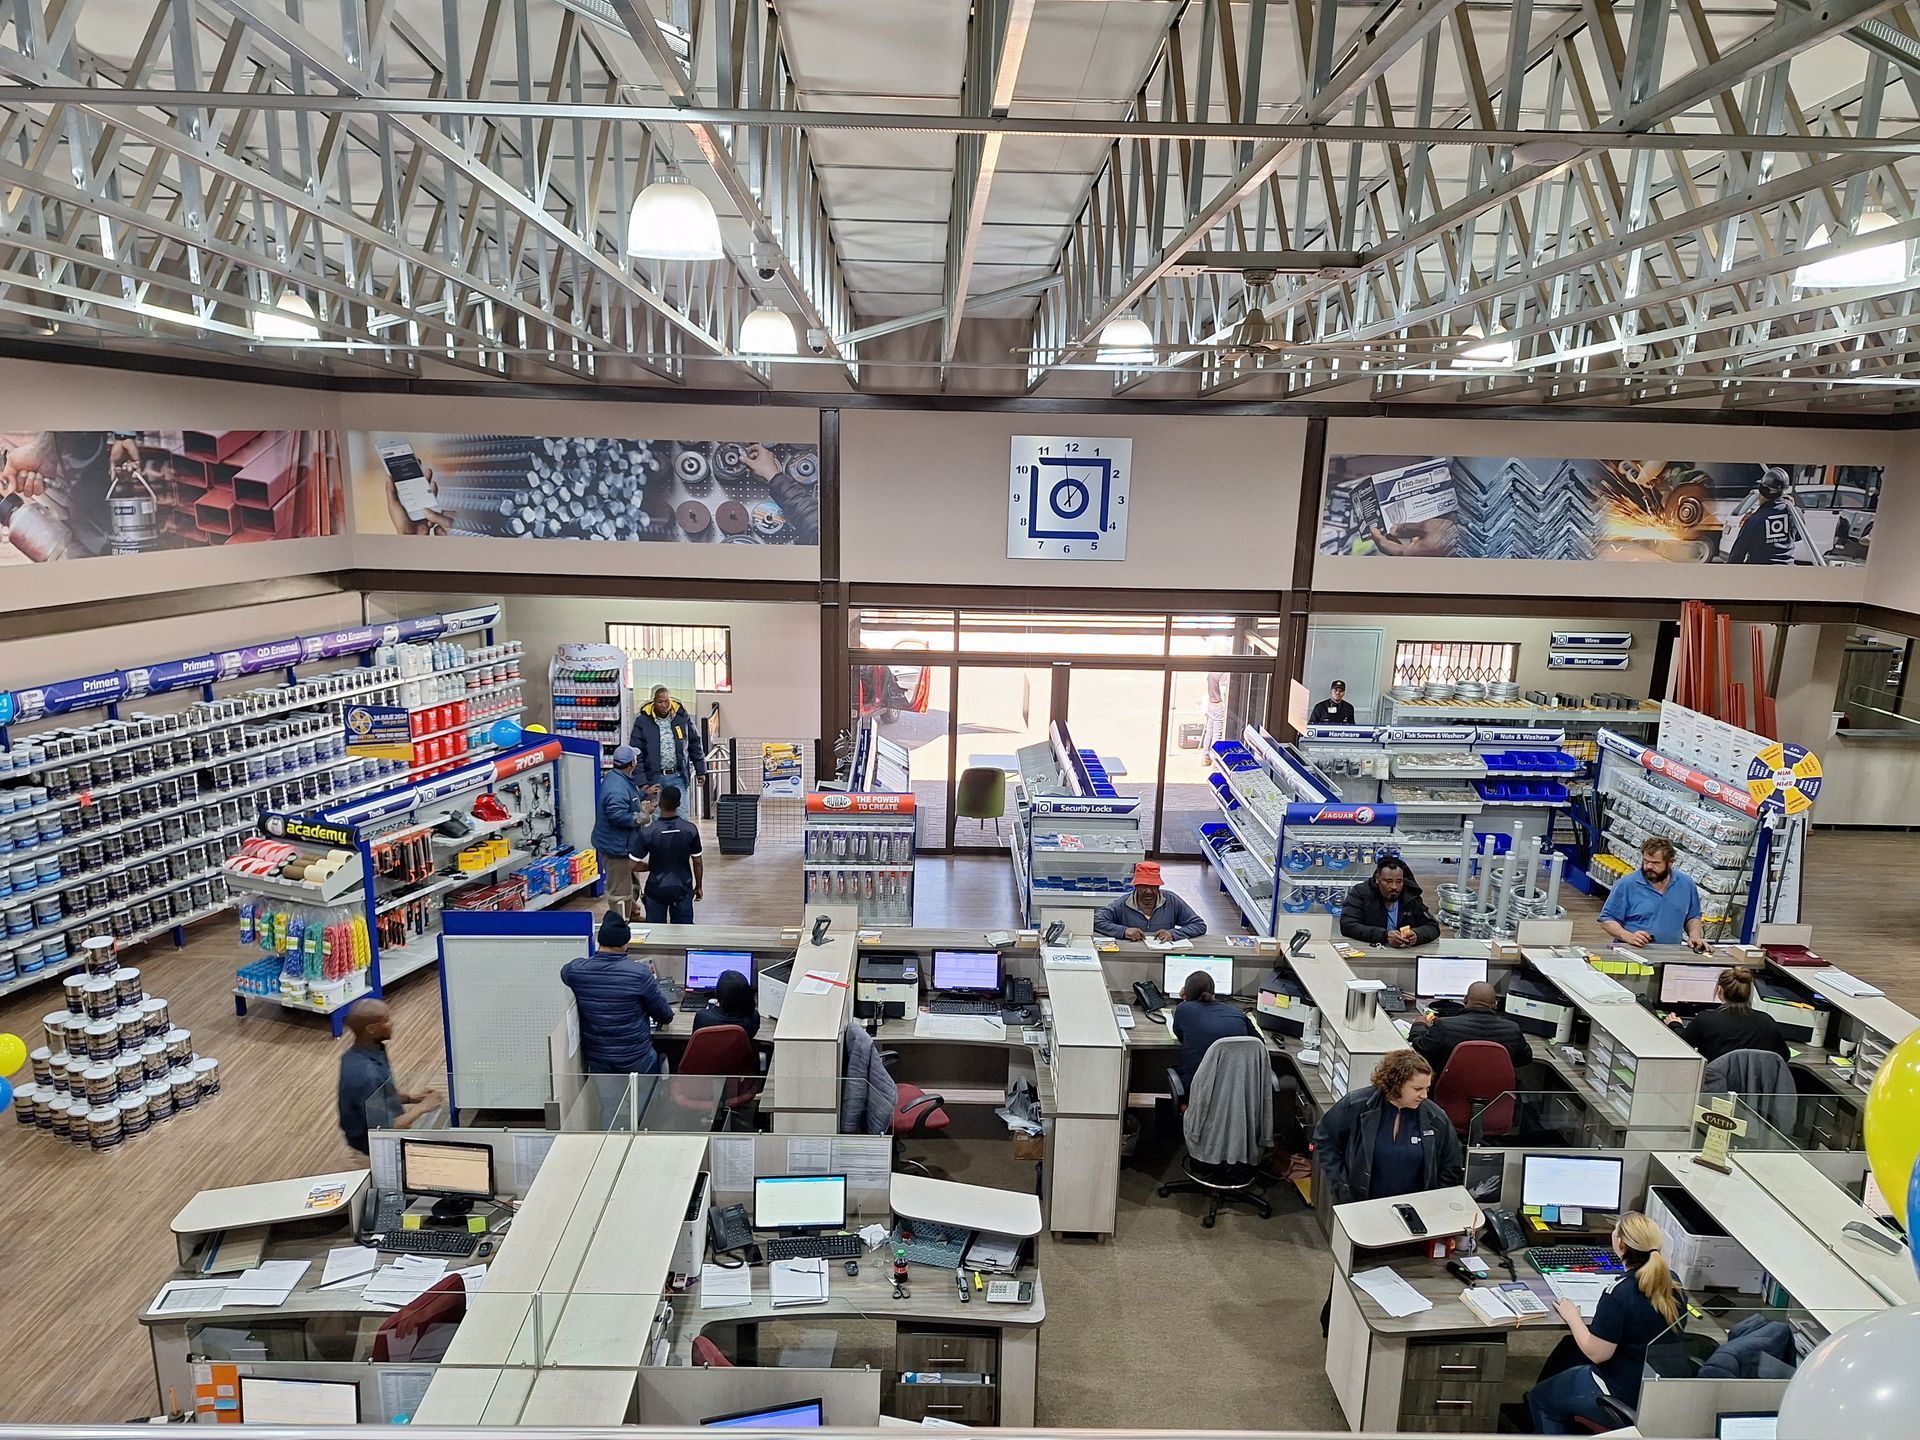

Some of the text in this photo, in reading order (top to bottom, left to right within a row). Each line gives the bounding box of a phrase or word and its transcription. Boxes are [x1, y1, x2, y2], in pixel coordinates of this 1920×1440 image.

[1037, 447, 1050, 456] 11
[1065, 443, 1079, 452] 12
[1094, 448, 1100, 457] 1
[1015, 466, 1029, 474] 10
[1112, 470, 1120, 478] 2
[1013, 494, 1021, 502] 9
[1117, 496, 1125, 504] 3
[1019, 518, 1027, 526] 8
[1108, 521, 1117, 530] 4
[1037, 541, 1045, 549] 7
[1063, 544, 1070, 553] 6
[1090, 542, 1098, 551] 5
[336, 633, 348, 644] QD
[348, 629, 372, 641] Enamel
[257, 642, 299, 657] QD Enamel
[183, 658, 215, 673] Primers
[83, 676, 120, 692] Primers
[1328, 730, 1360, 738] Hardware
[1406, 731, 1416, 739] Tek
[1442, 732, 1465, 740] Washers
[1521, 733, 1550, 741] Washers
[514, 751, 544, 772] RYOBI
[450, 775, 484, 792] Power tools
[868, 803, 898, 811] CREATE
[1060, 805, 1112, 814] Security Locks
[367, 807, 385, 819] Tools
[286, 823, 347, 845] academy
[1706, 1115, 1733, 1129] FAITH
